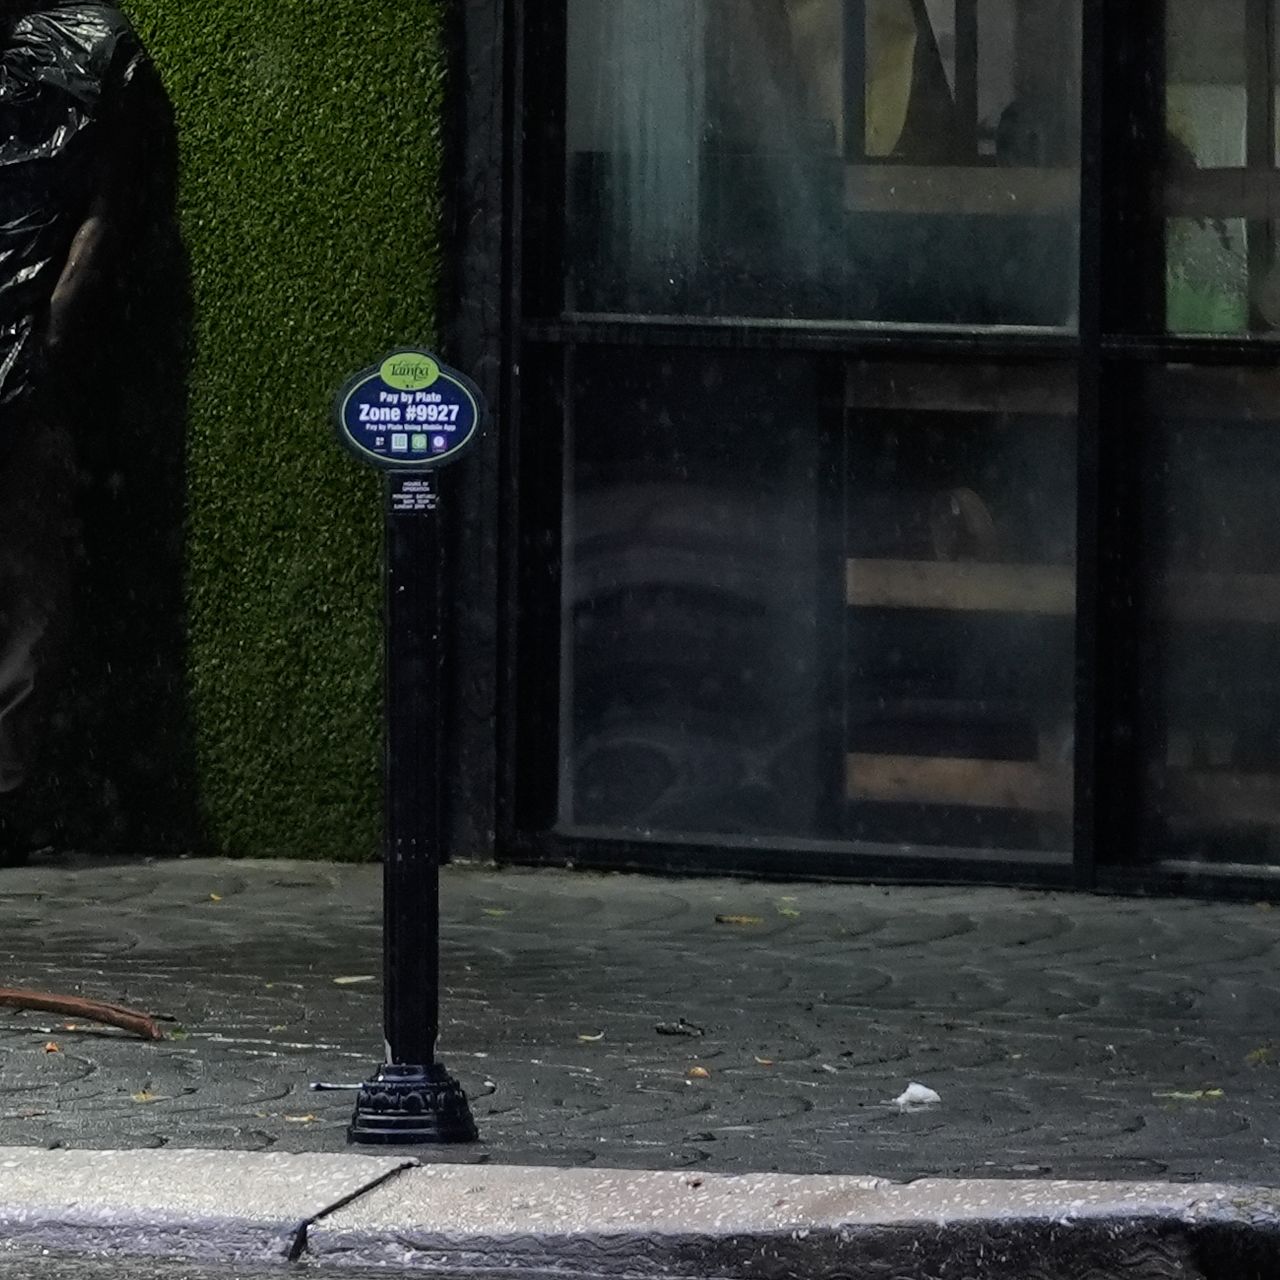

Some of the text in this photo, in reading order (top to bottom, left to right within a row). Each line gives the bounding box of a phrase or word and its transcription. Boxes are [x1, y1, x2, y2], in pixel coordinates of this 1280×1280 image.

[389, 362, 430, 381] Tampa
[380, 391, 442, 404] Pay by Plate
[359, 404, 460, 422] Zone #9927
